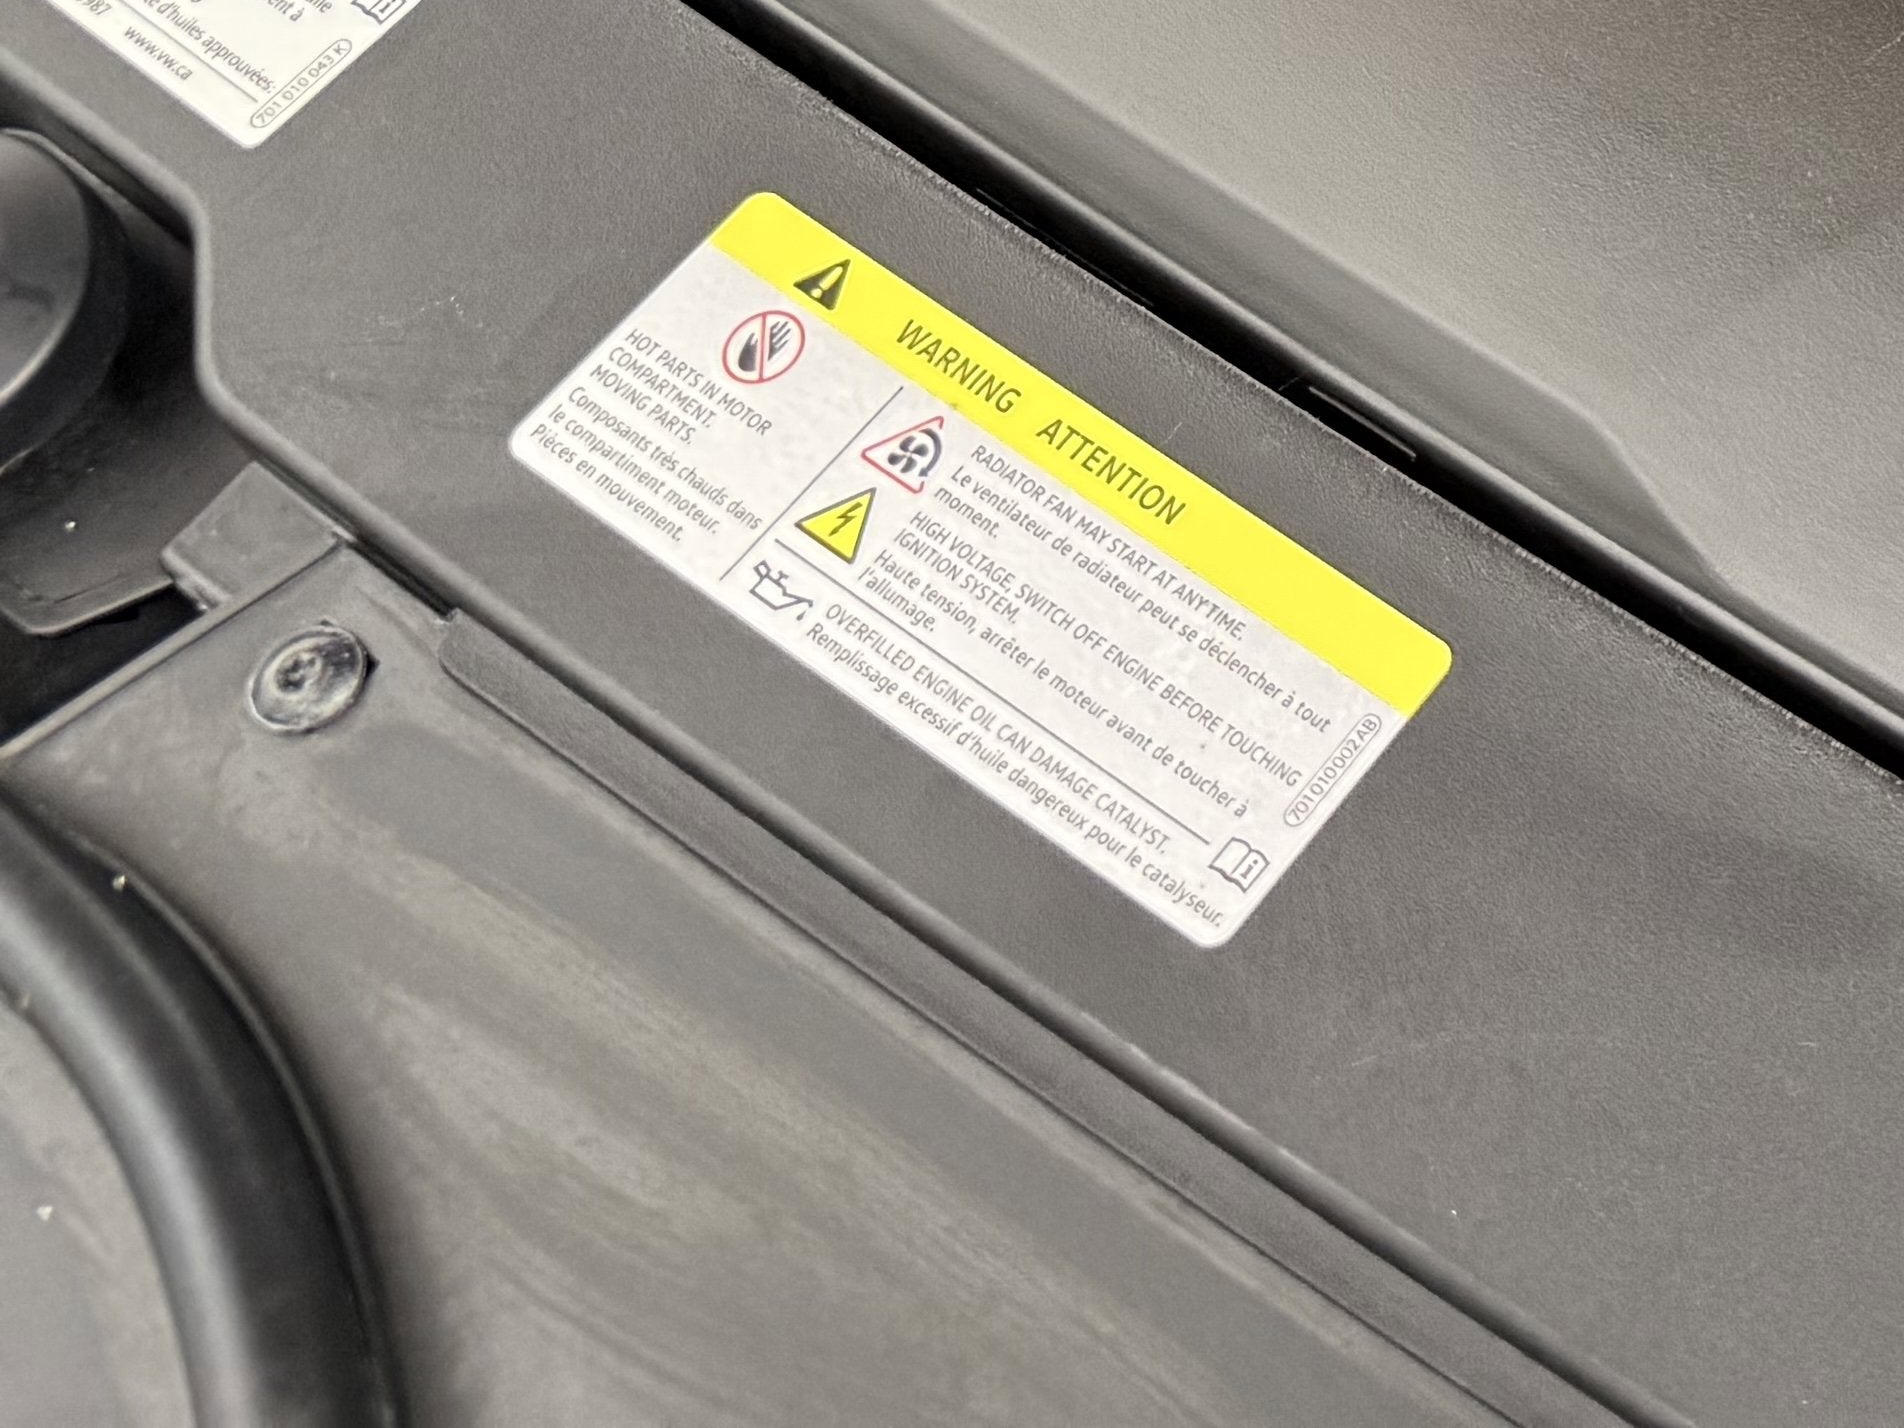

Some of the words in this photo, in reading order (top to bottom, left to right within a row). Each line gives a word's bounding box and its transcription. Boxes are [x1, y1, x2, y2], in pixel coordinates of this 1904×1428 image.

[123, 25, 193, 81] www.vw.ca
[155, 1, 206, 41] d'huiles
[200, 34, 276, 94] approuvées:
[288, 6, 305, 22] à
[255, 100, 282, 124] 701
[280, 75, 310, 101] 010
[306, 54, 335, 78] 043
[332, 43, 348, 56] K
[588, 362, 652, 411] MOVING
[645, 402, 697, 445] PARTS.
[607, 345, 717, 429] COMPARTMENT.
[623, 327, 662, 357] HOT
[654, 348, 705, 388] PARTS
[698, 379, 722, 401] IN
[715, 391, 773, 436] MOTOR
[895, 318, 1022, 414] WARNING
[1034, 417, 1186, 526] ATTENTION
[528, 422, 578, 464] Pièces
[574, 458, 597, 479] en
[593, 472, 684, 542] mouvement.
[547, 402, 566, 424] le
[563, 418, 666, 496] compartiment
[661, 487, 720, 535] moteur.
[567, 385, 653, 453] Composants
[648, 444, 680, 473] très
[675, 465, 729, 507] chauds
[724, 499, 763, 530] dans
[932, 486, 1000, 539] moment.
[856, 565, 936, 633] l'allumage.
[892, 527, 964, 582] IGNITION
[958, 572, 1021, 625] SYSTEM.
[949, 464, 973, 488] Le
[971, 480, 1053, 541] ventilateur
[1049, 535, 1073, 557] de
[1070, 550, 1144, 603] radiateur
[1136, 597, 1180, 630] peut
[1176, 623, 1199, 643] se
[1197, 636, 1284, 699] déclencher
[1279, 689, 1296, 709] à
[1293, 700, 1331, 733] tout
[969, 443, 1047, 503] RADIATOR
[1041, 492, 1078, 524] FAN
[1072, 514, 1112, 545] MAY
[1105, 536, 1158, 577] START
[1150, 568, 1178, 590] AT
[1170, 581, 1209, 613] ANY
[1202, 602, 1251, 641] TIME.
[872, 547, 921, 590] Haute
[919, 582, 977, 635] tension,
[978, 625, 1036, 668] arrêter
[1031, 658, 1050, 680] le
[1047, 673, 1109, 719] moteur
[1104, 713, 1153, 752] avant
[1150, 744, 1175, 767] de
[1172, 758, 1237, 808] toucher
[1232, 798, 1249, 818] à
[908, 509, 952, 545] HIGH
[947, 534, 1016, 594] VOLTAGE,
[1013, 582, 1077, 631] SWITCH
[1071, 622, 1108, 650] OFF
[1101, 642, 1165, 692] ENGINE
[1157, 682, 1224, 734] BEFORE
[1219, 722, 1303, 787] TOUCHING
[804, 621, 899, 696] Remplissage
[896, 689, 963, 737] excessif
[954, 730, 1009, 774] d'huile
[1006, 766, 1090, 831] dangereux
[1082, 823, 1127, 856] pour
[1123, 844, 1142, 869] le
[1140, 862, 1224, 928] catalyseur.
[824, 602, 916, 672] OVERFILLED
[911, 663, 975, 713] ENGINE
[968, 703, 997, 732] OIL
[995, 722, 1033, 755] CAN
[1026, 745, 1099, 801] DAMAGE
[1093, 792, 1171, 855] CATALYST.
